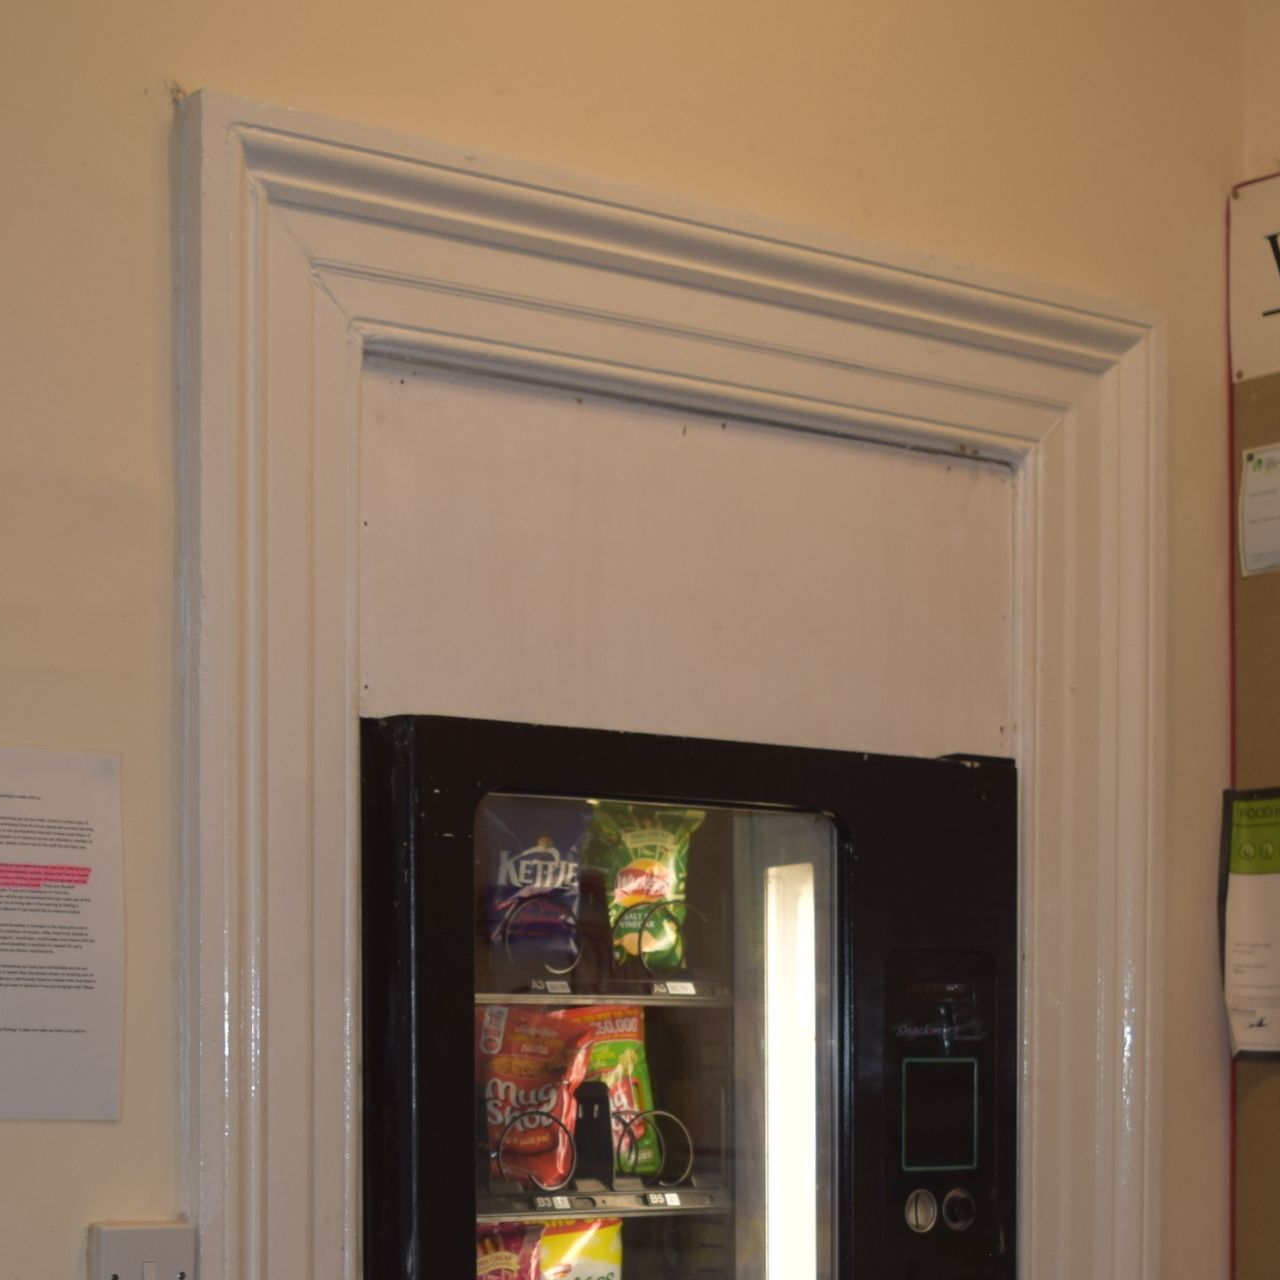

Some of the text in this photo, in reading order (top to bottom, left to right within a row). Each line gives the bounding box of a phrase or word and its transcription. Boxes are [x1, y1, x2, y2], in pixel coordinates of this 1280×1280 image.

[496, 850, 579, 890] KETTLE
[484, 1078, 559, 1112] Mug
[537, 1196, 552, 1208] B3
[649, 1193, 664, 1204] B5
